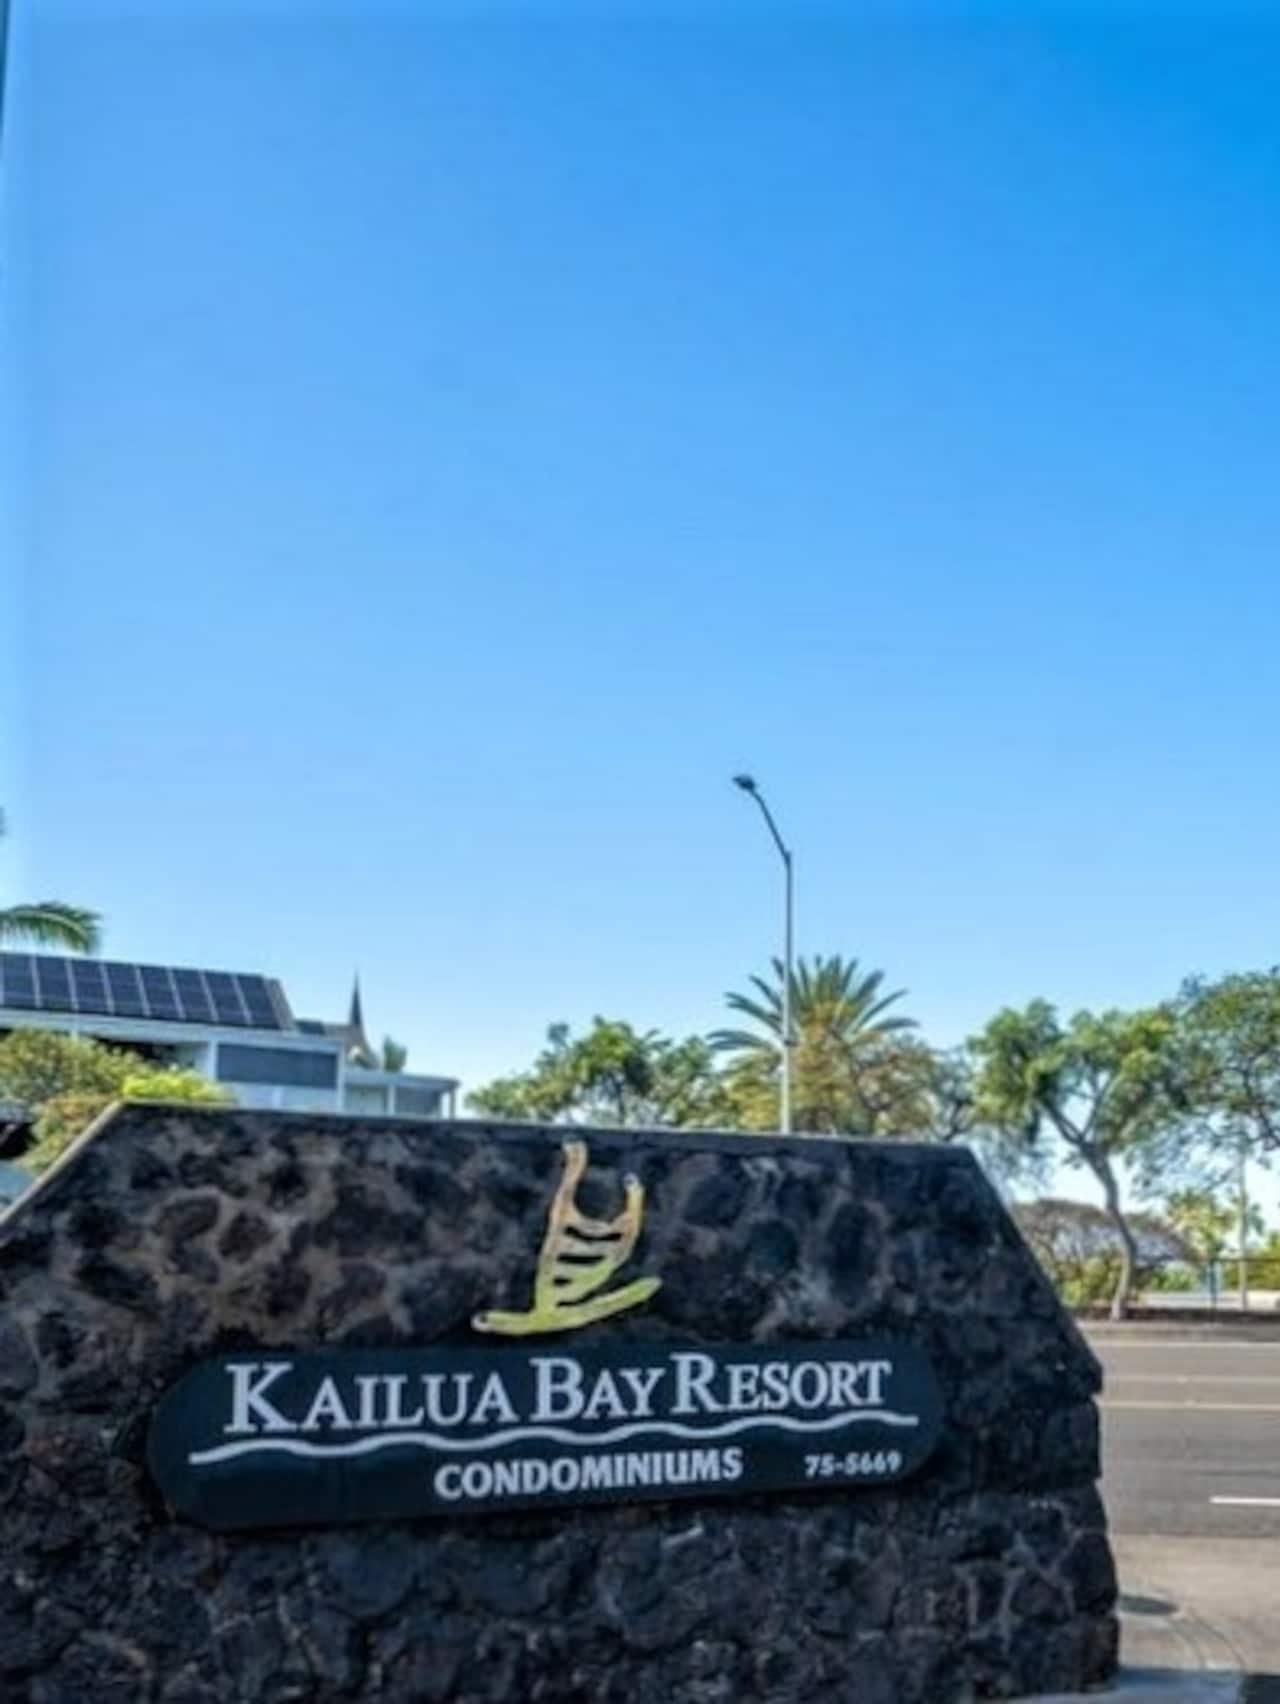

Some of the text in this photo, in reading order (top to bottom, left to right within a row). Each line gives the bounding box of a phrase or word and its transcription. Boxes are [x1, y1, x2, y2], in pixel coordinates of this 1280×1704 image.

[224, 1353, 892, 1433] KAILUA BAY RESORT
[434, 1448, 902, 1500] CONDOMINIUMS 75-5669
